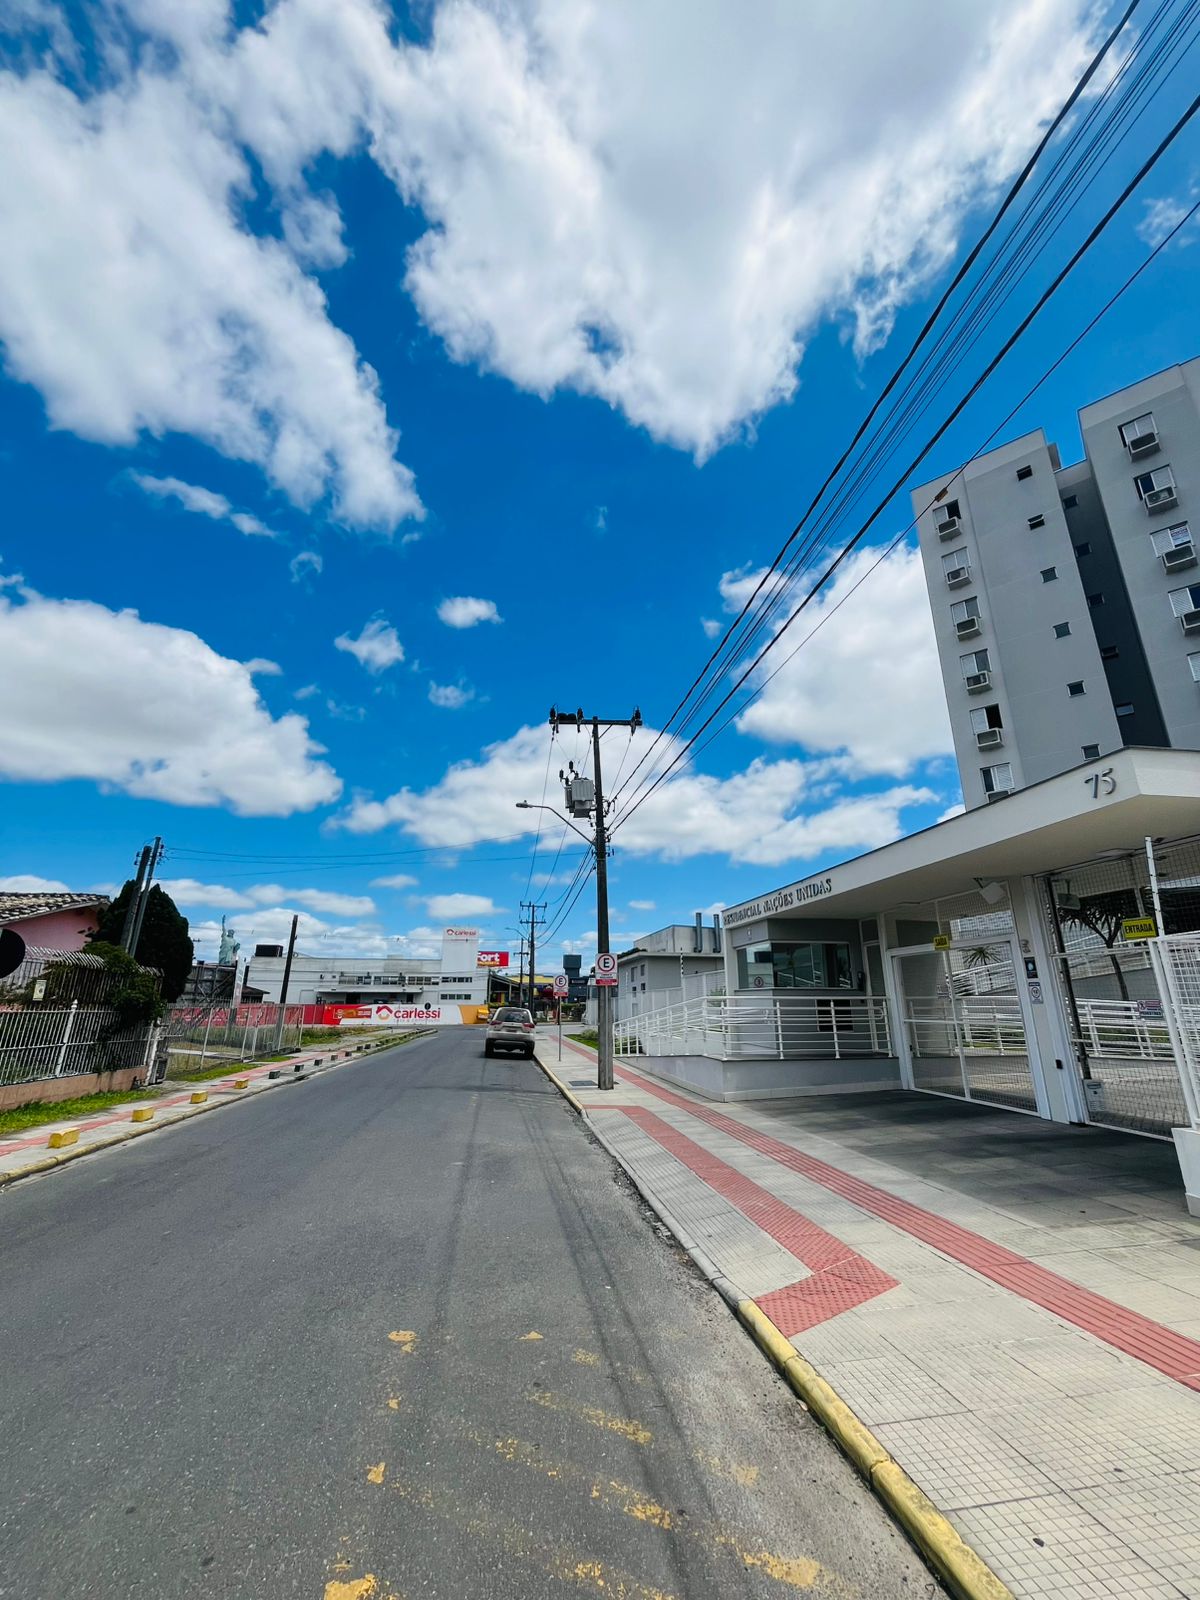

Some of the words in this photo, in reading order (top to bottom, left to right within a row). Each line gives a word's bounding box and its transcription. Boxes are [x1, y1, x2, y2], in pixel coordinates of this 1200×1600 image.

[1084, 768, 1116, 799] 75
[796, 878, 832, 902] UNIDAS
[1124, 923, 1153, 934] ENTRADA
[603, 957, 610, 968] E
[394, 1007, 441, 1019] carlessi
